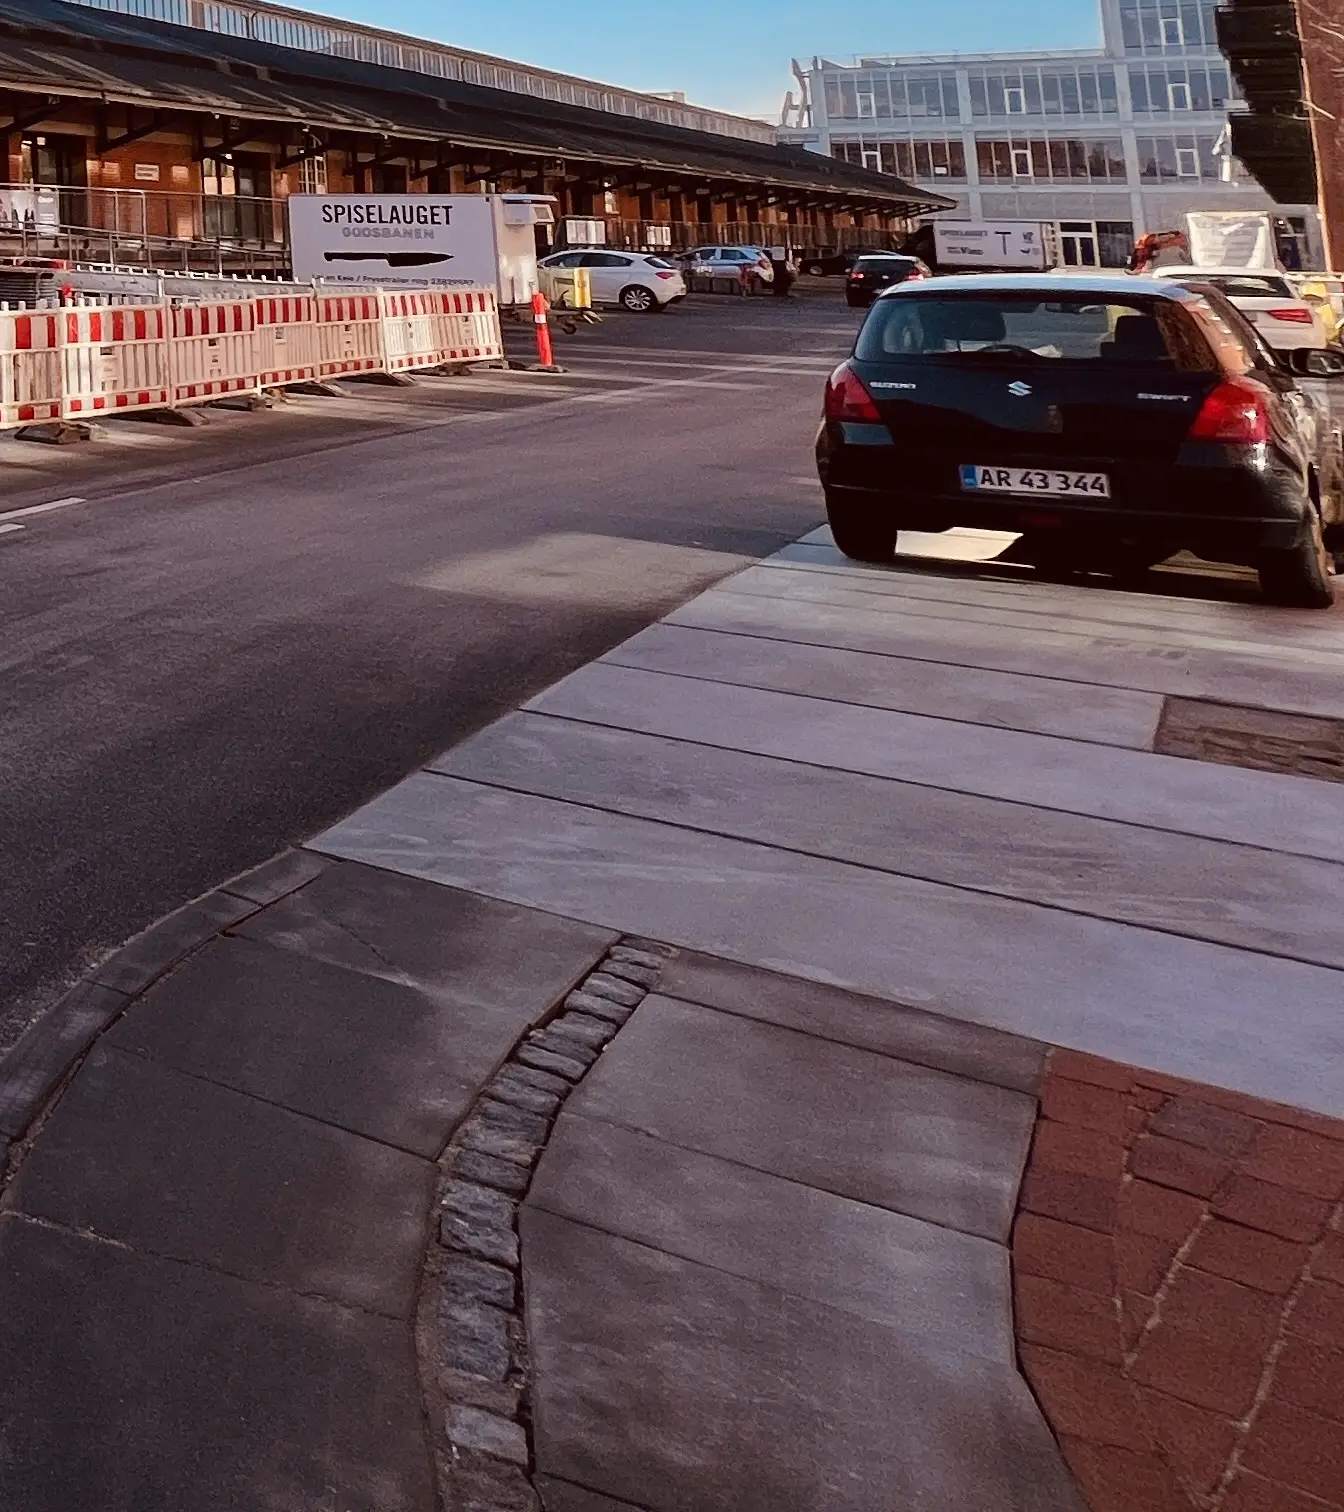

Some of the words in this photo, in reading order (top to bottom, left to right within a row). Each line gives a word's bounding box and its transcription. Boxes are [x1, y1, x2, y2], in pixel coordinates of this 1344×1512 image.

[322, 204, 453, 226] SPISELAUGET
[342, 226, 435, 239] GODSBANEN
[980, 469, 1011, 487] AR
[1019, 471, 1049, 489] 43
[1056, 473, 1105, 494] 344
